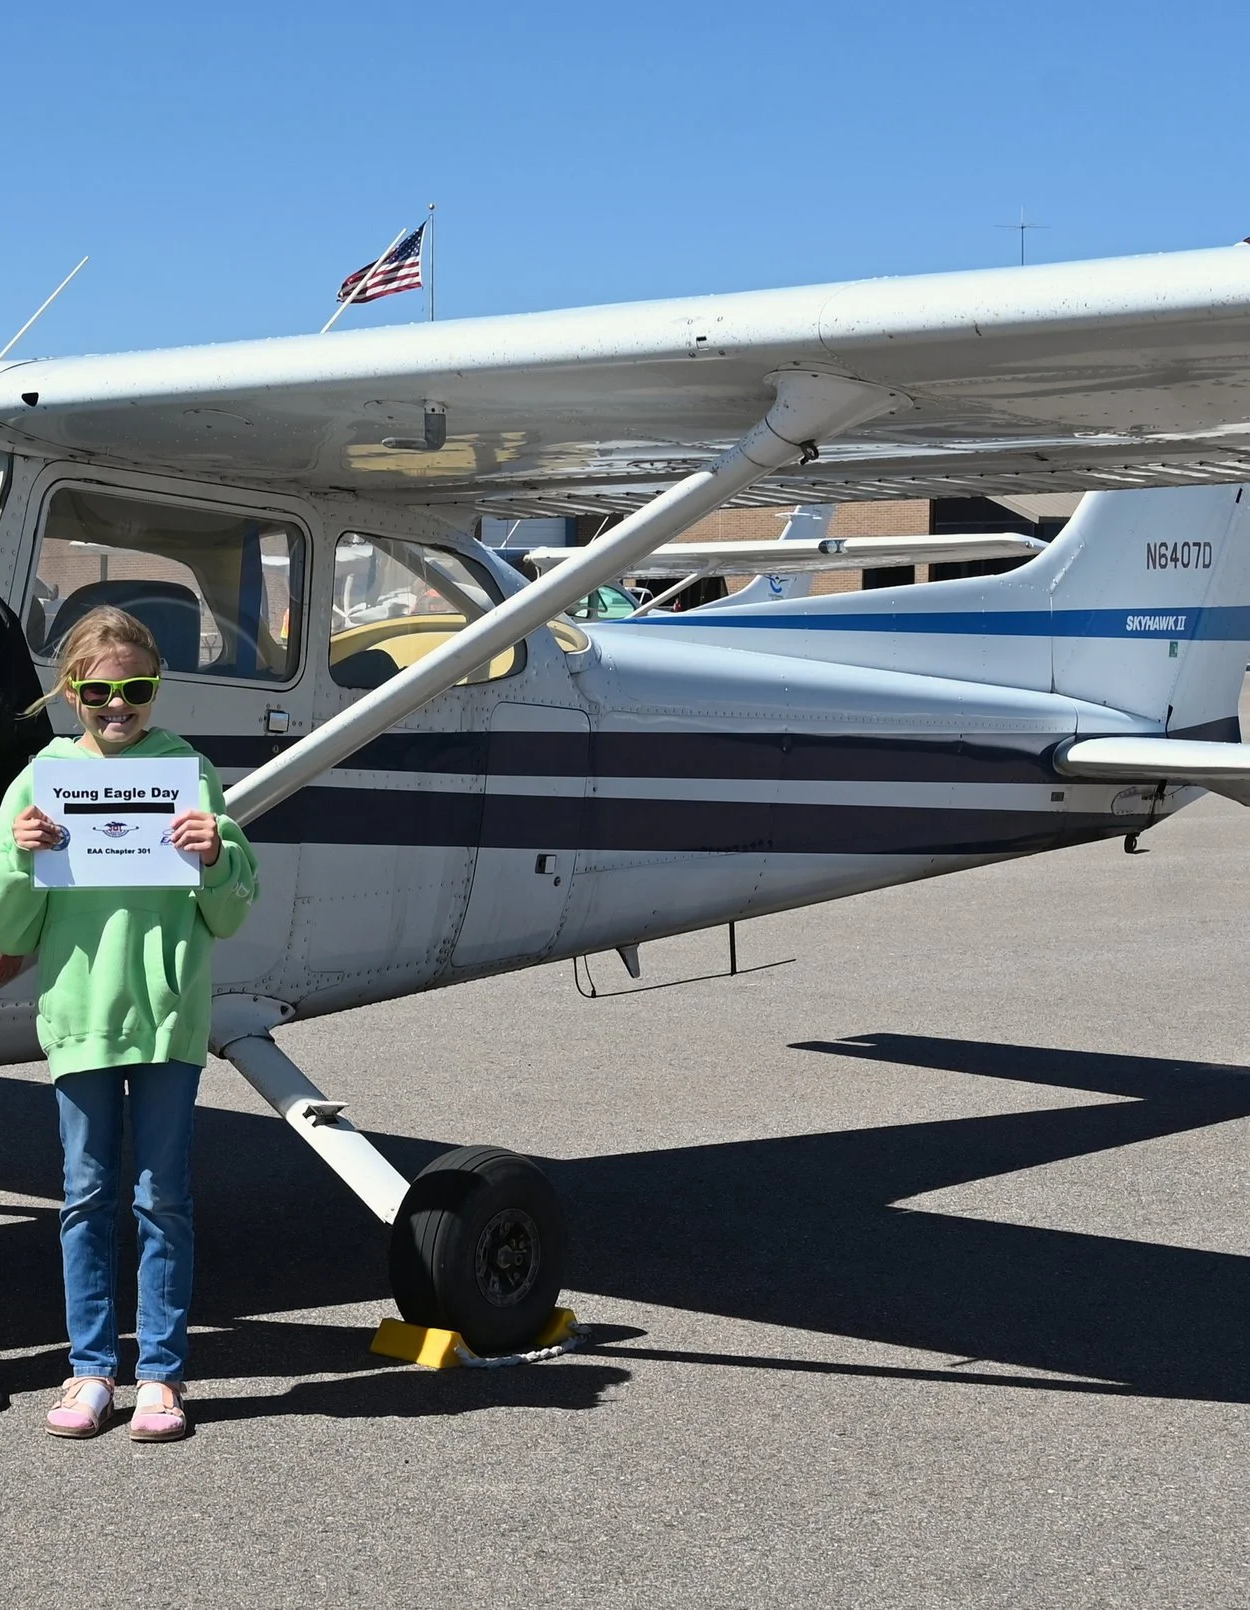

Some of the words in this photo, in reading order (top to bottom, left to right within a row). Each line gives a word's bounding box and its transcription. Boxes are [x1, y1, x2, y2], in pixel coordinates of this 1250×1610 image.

[1146, 541, 1212, 570] N6407D
[1126, 616, 1177, 631] SKYHAWK
[53, 788, 99, 801] Young
[104, 787, 146, 801] Eagle
[151, 787, 179, 800] Day
[105, 848, 135, 856] Chapter
